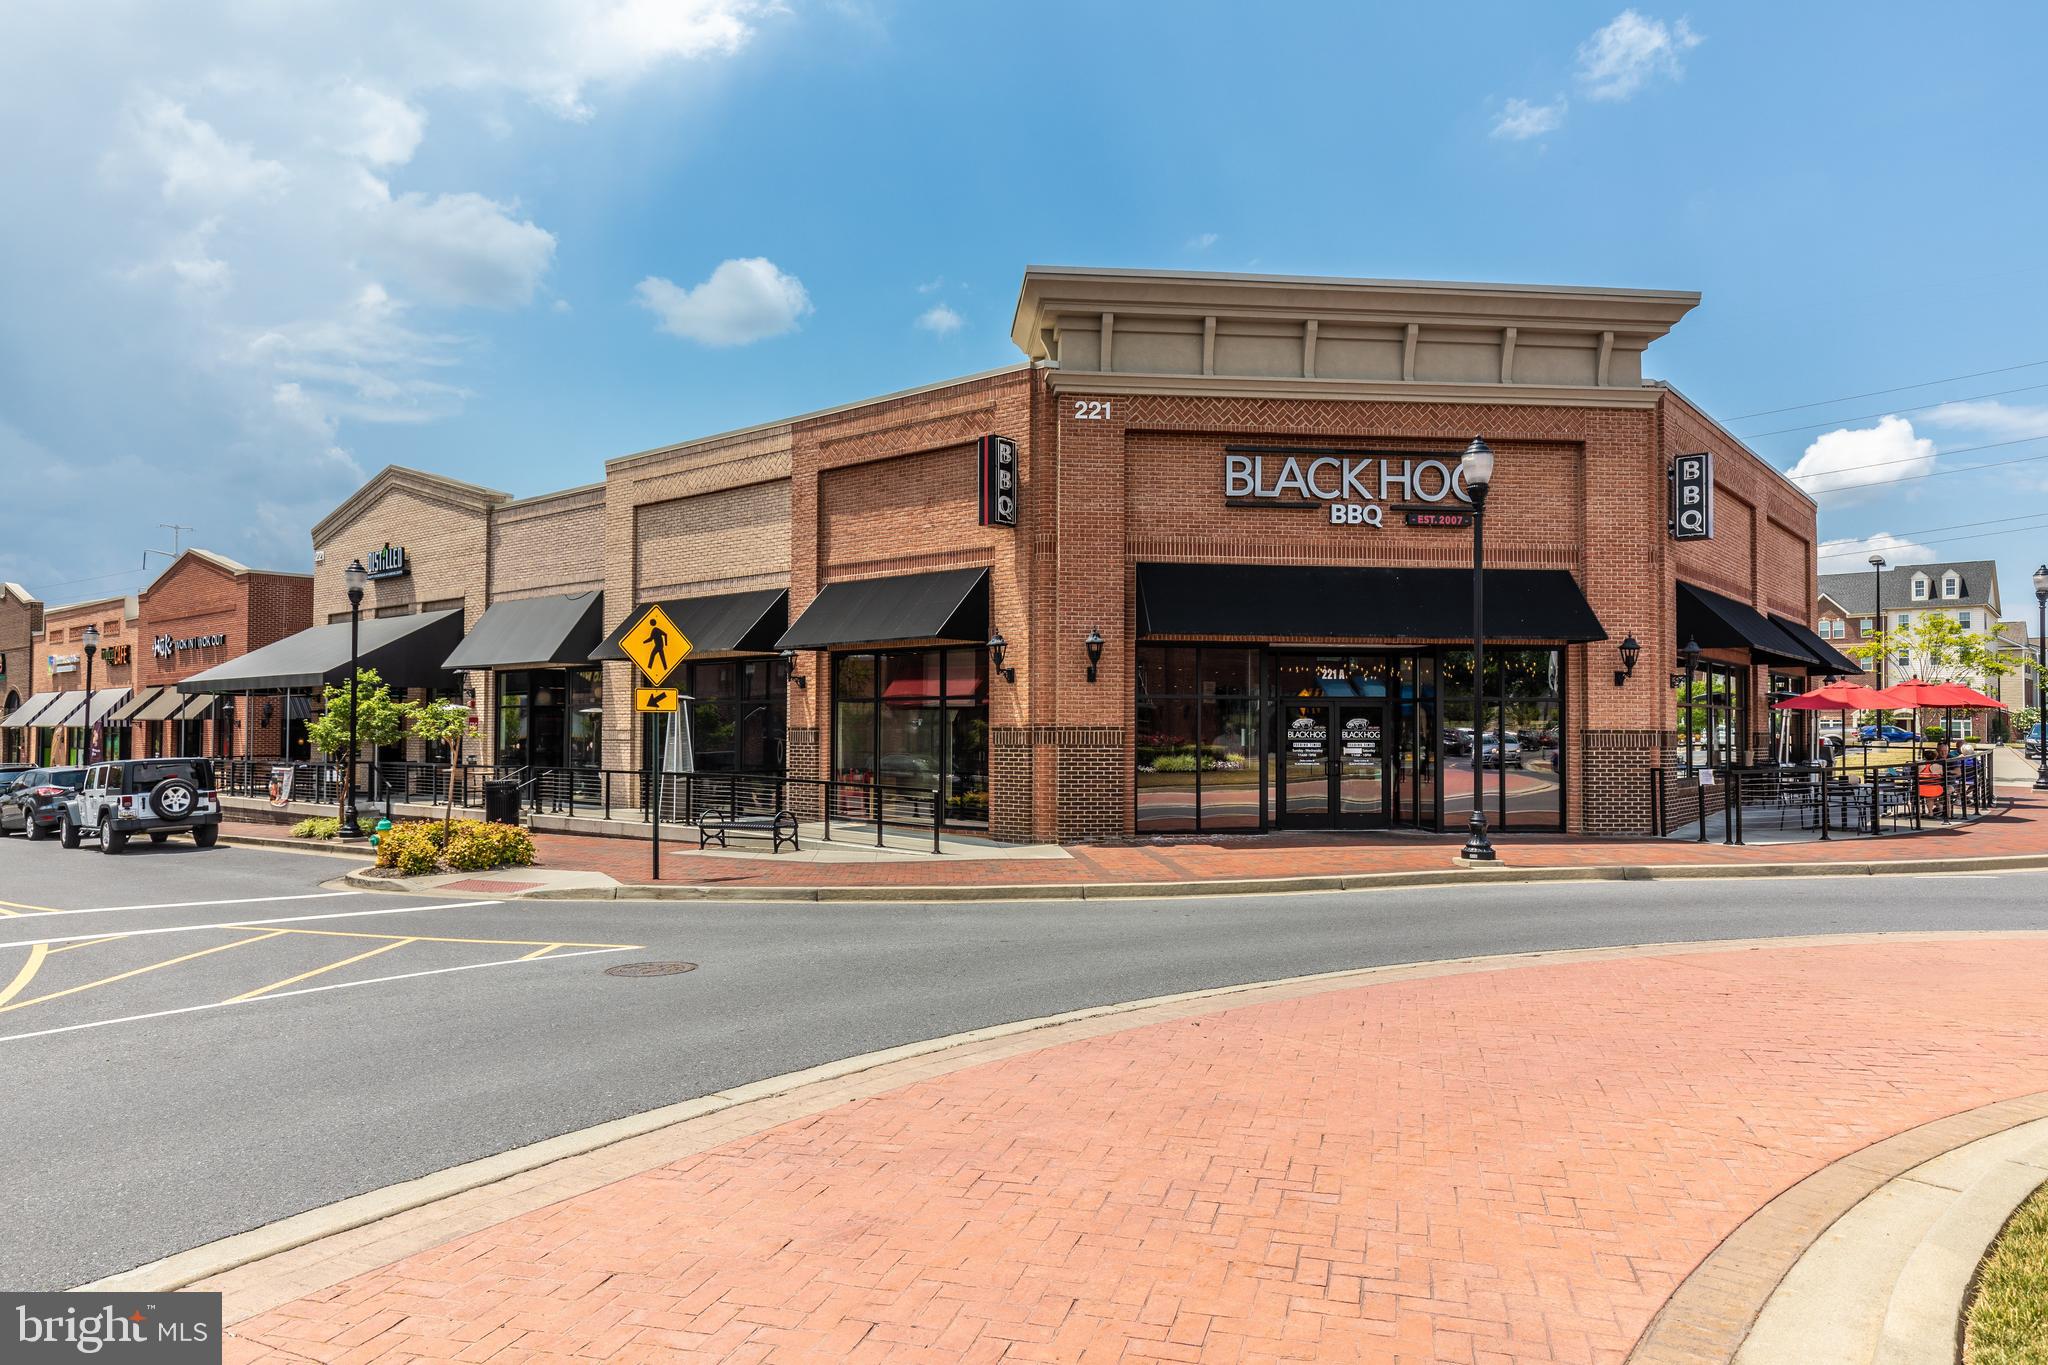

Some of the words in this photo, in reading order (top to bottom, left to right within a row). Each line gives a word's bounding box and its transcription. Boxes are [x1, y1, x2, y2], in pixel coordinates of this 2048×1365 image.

[1074, 400, 1111, 420] 221
[999, 442, 1014, 521] BBQ
[1225, 455, 1374, 501] BLACK
[1680, 460, 1703, 532] BBQ
[1331, 504, 1383, 528] BBQ
[1417, 515, 1438, 525] EST.
[1439, 515, 1463, 525] 2007
[211, 634, 224, 646] OUT
[1322, 668, 1337, 680] 221
[1338, 668, 1345, 680] A
[1287, 730, 1309, 739] BLACK
[1309, 730, 1327, 739] HOG
[1341, 730, 1363, 739] BLACK
[1363, 730, 1381, 739] HOG
